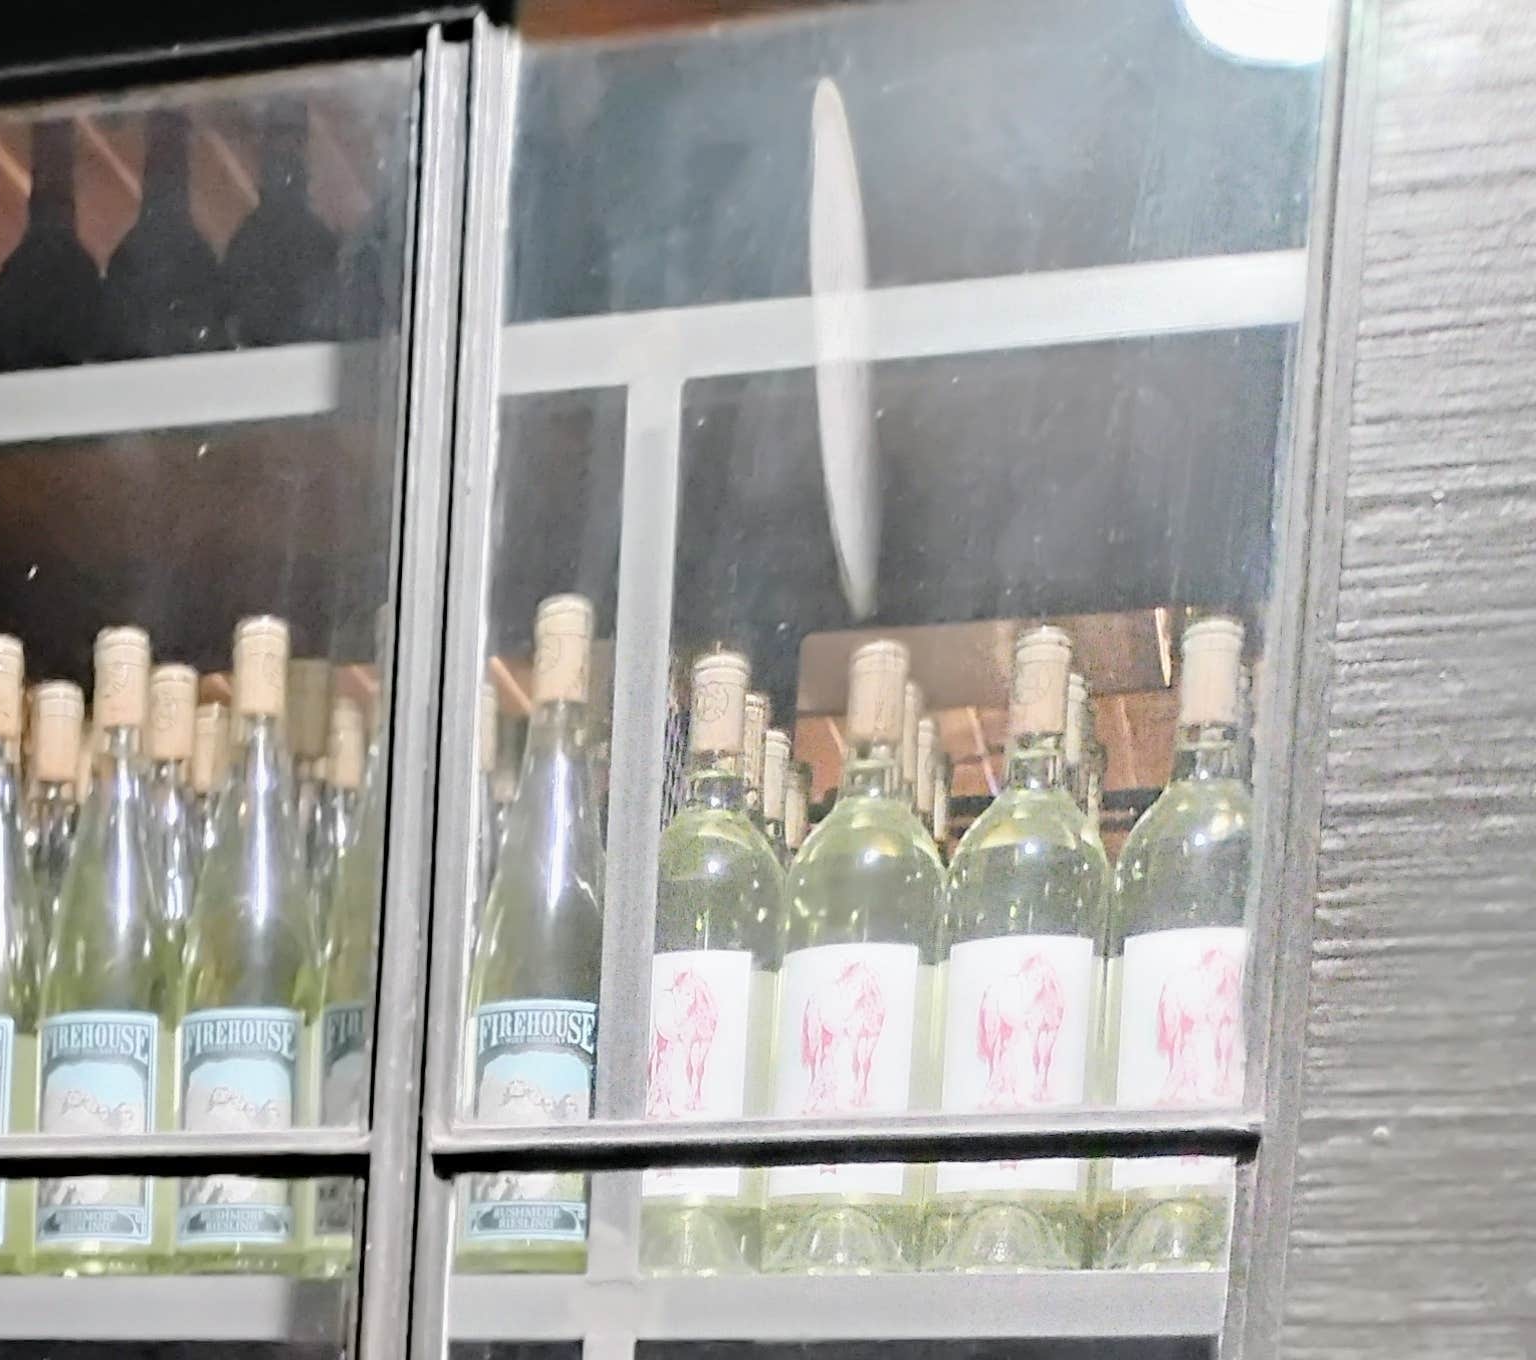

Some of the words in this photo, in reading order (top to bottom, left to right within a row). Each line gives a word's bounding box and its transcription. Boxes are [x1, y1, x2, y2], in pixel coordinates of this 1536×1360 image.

[43, 1023, 150, 1066] FIREHOUSE
[183, 1018, 296, 1065] FIREHOUSE
[477, 1010, 596, 1056] FIREHOUSE
[493, 1206, 561, 1219] RUSHMORE
[498, 1216, 554, 1230] RIESLING
